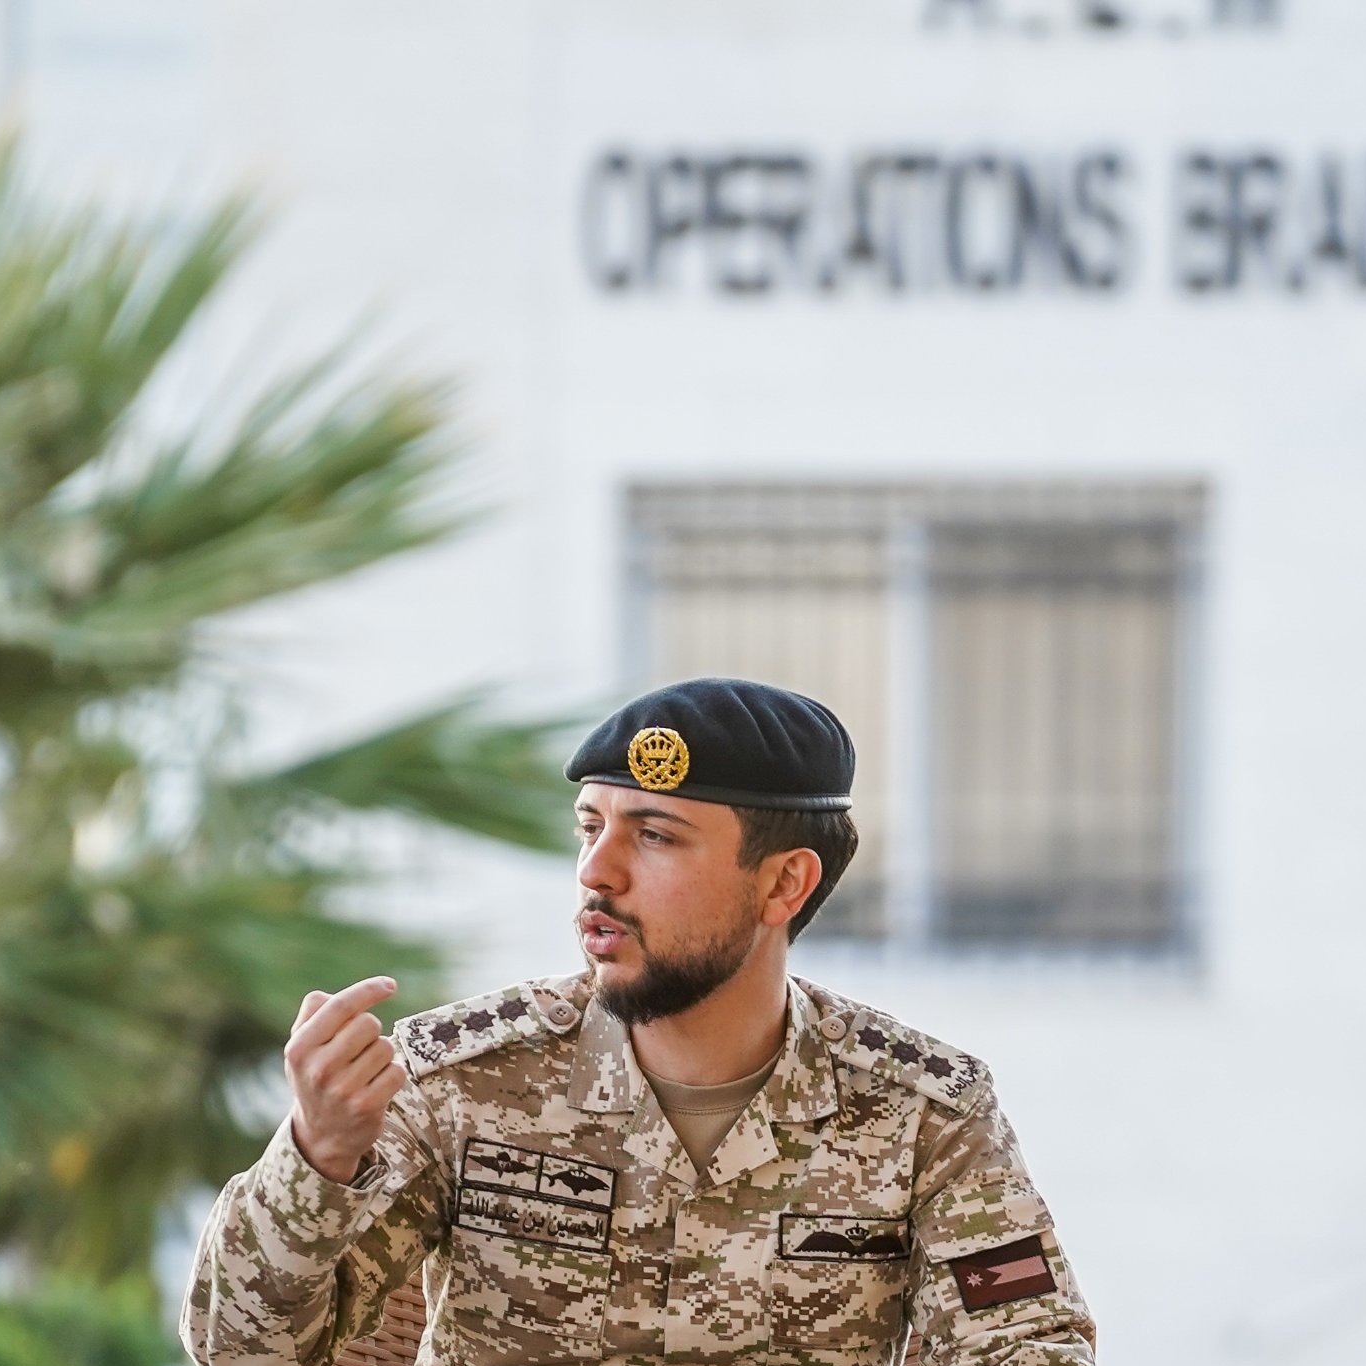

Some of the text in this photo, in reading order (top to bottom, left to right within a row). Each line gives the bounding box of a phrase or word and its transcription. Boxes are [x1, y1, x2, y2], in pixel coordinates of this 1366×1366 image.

[586, 145, 1131, 294] OPERATIONS
[521, 1210, 547, 1234] بن
[547, 1216, 604, 1238] الحسين
